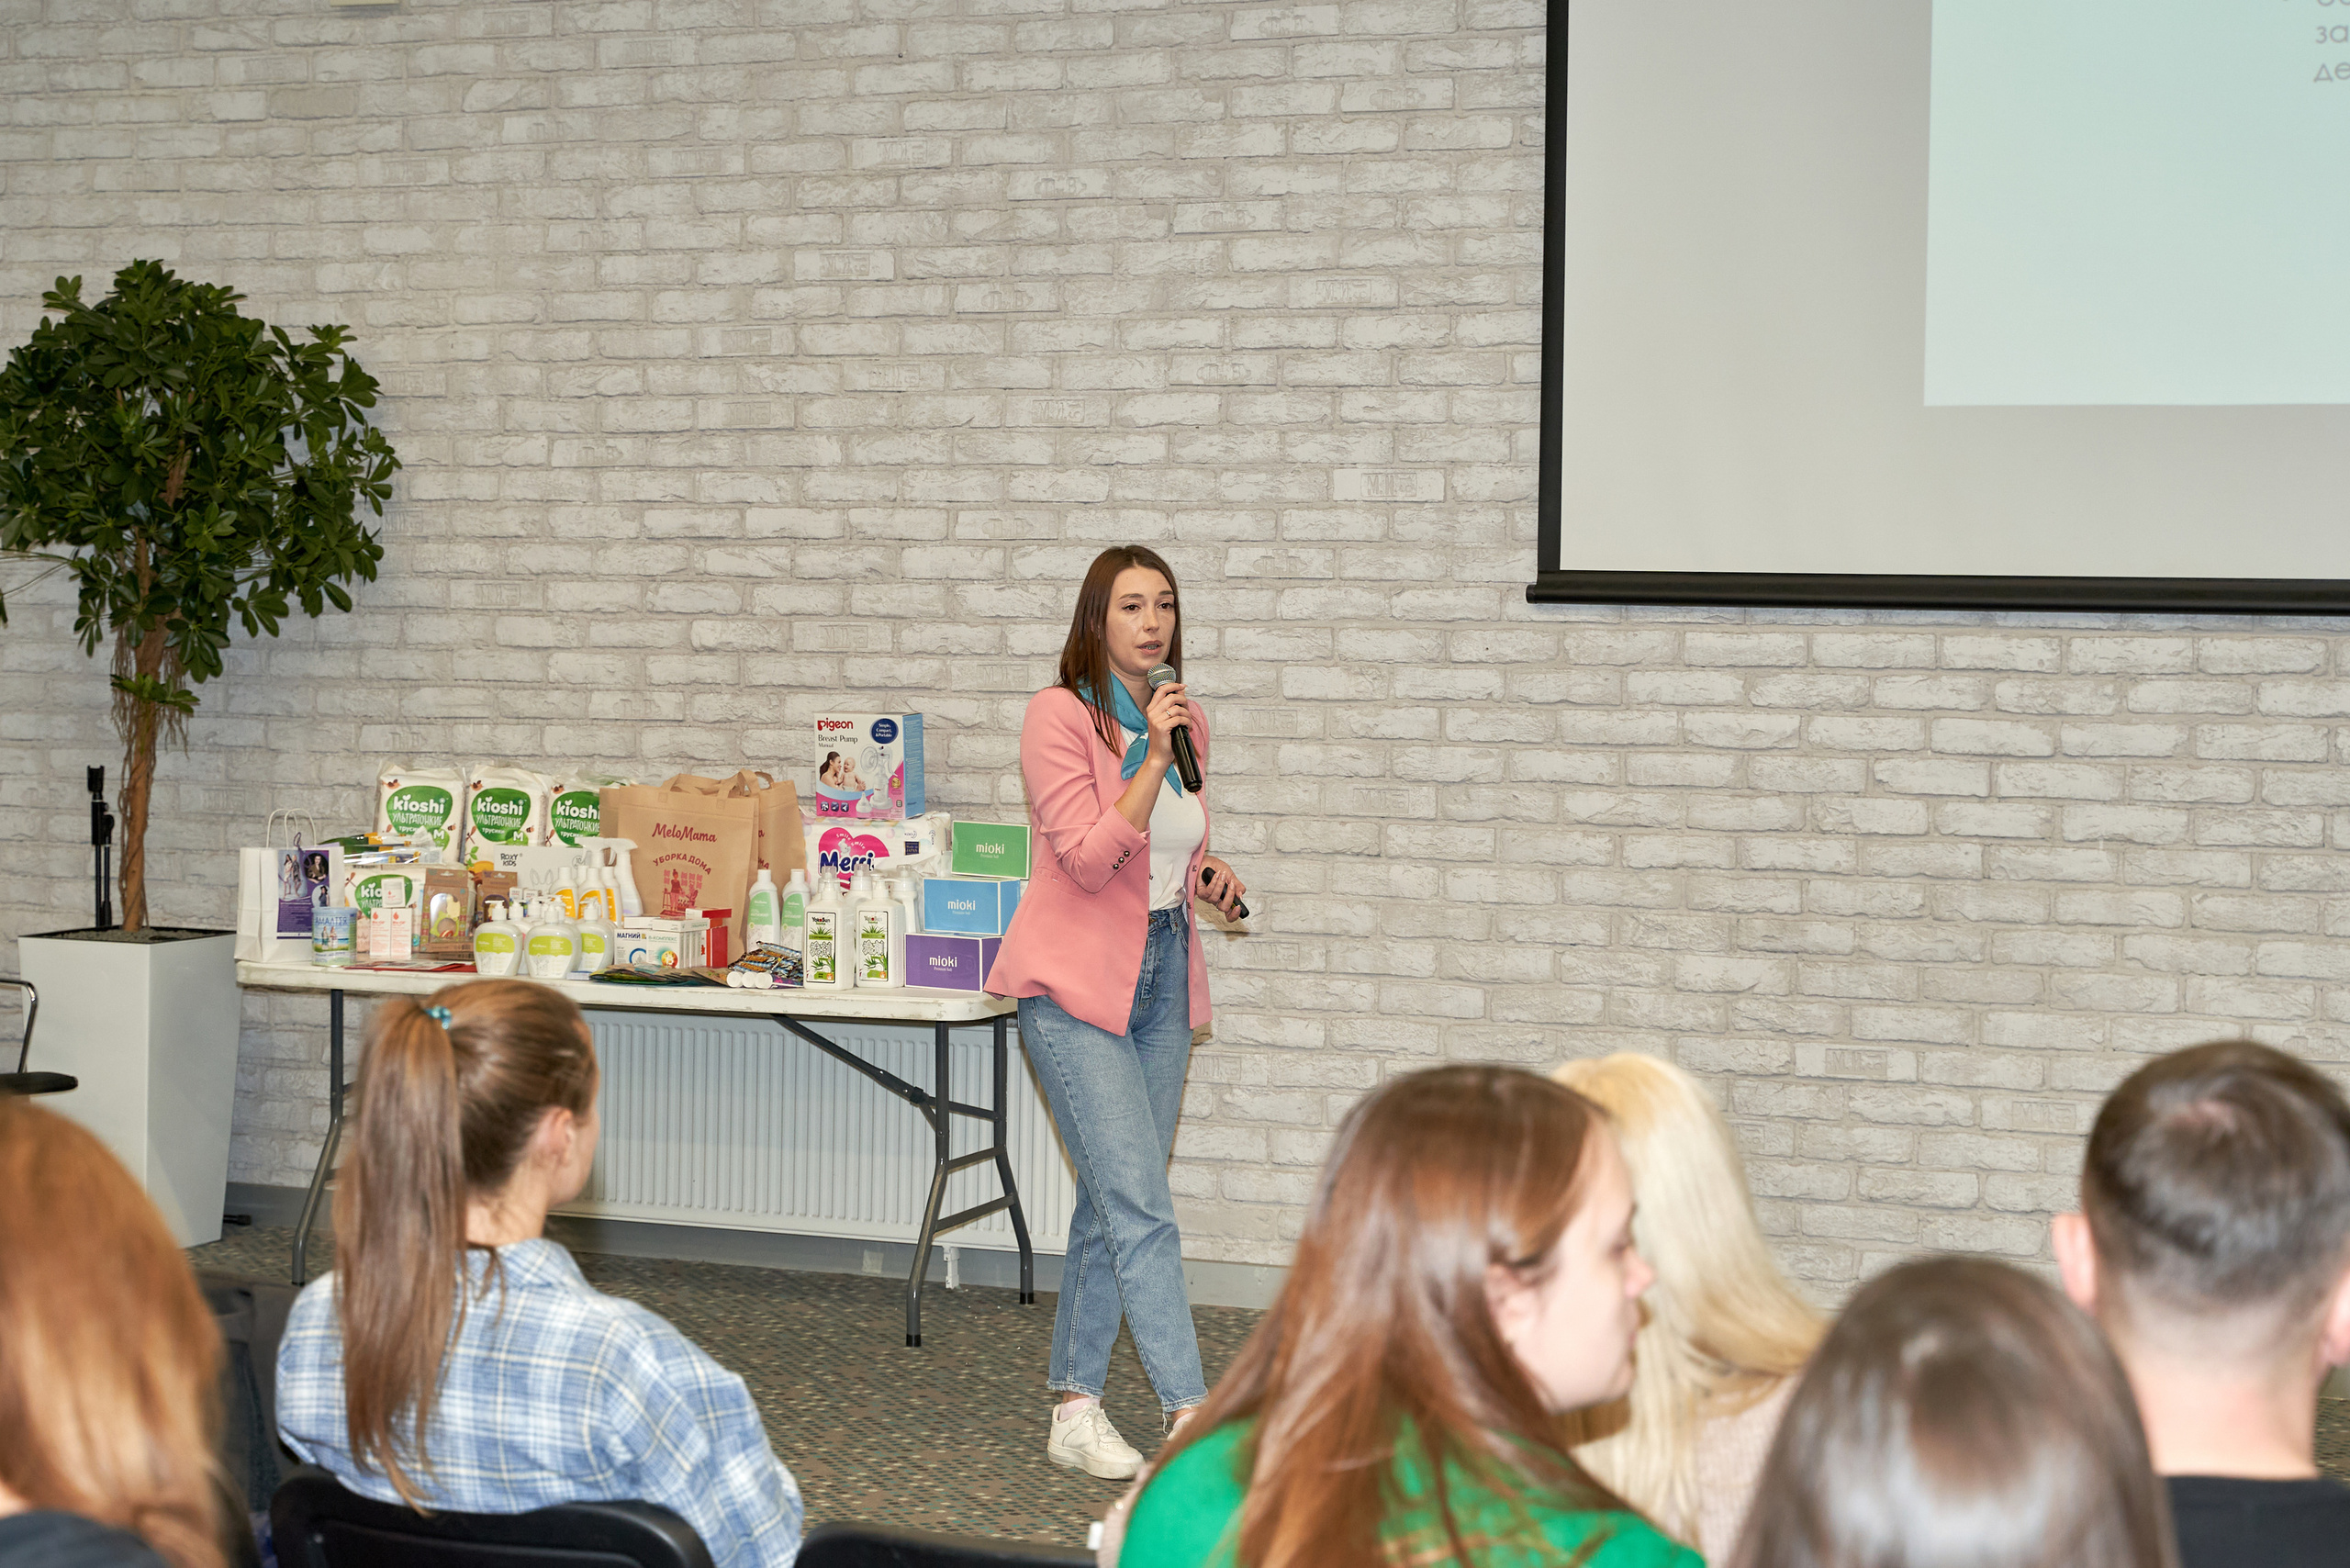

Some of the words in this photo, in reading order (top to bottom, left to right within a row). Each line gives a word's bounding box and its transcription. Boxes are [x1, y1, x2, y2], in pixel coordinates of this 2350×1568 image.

[839, 734, 858, 744] Pump
[393, 794, 446, 814] kioshi
[476, 796, 524, 816] kioshi
[392, 812, 442, 826] УЛЬТРАТОНКИЕ
[476, 814, 521, 828] УЛЬТРАТОНКИЕ
[433, 829, 445, 840] M
[513, 831, 524, 842] M
[652, 823, 717, 843] MeloMama
[976, 843, 1005, 855] mioki
[653, 853, 688, 867] УБОРКА
[688, 855, 711, 875] ДОМА
[947, 899, 976, 911] mioki
[929, 956, 957, 968] mioki
